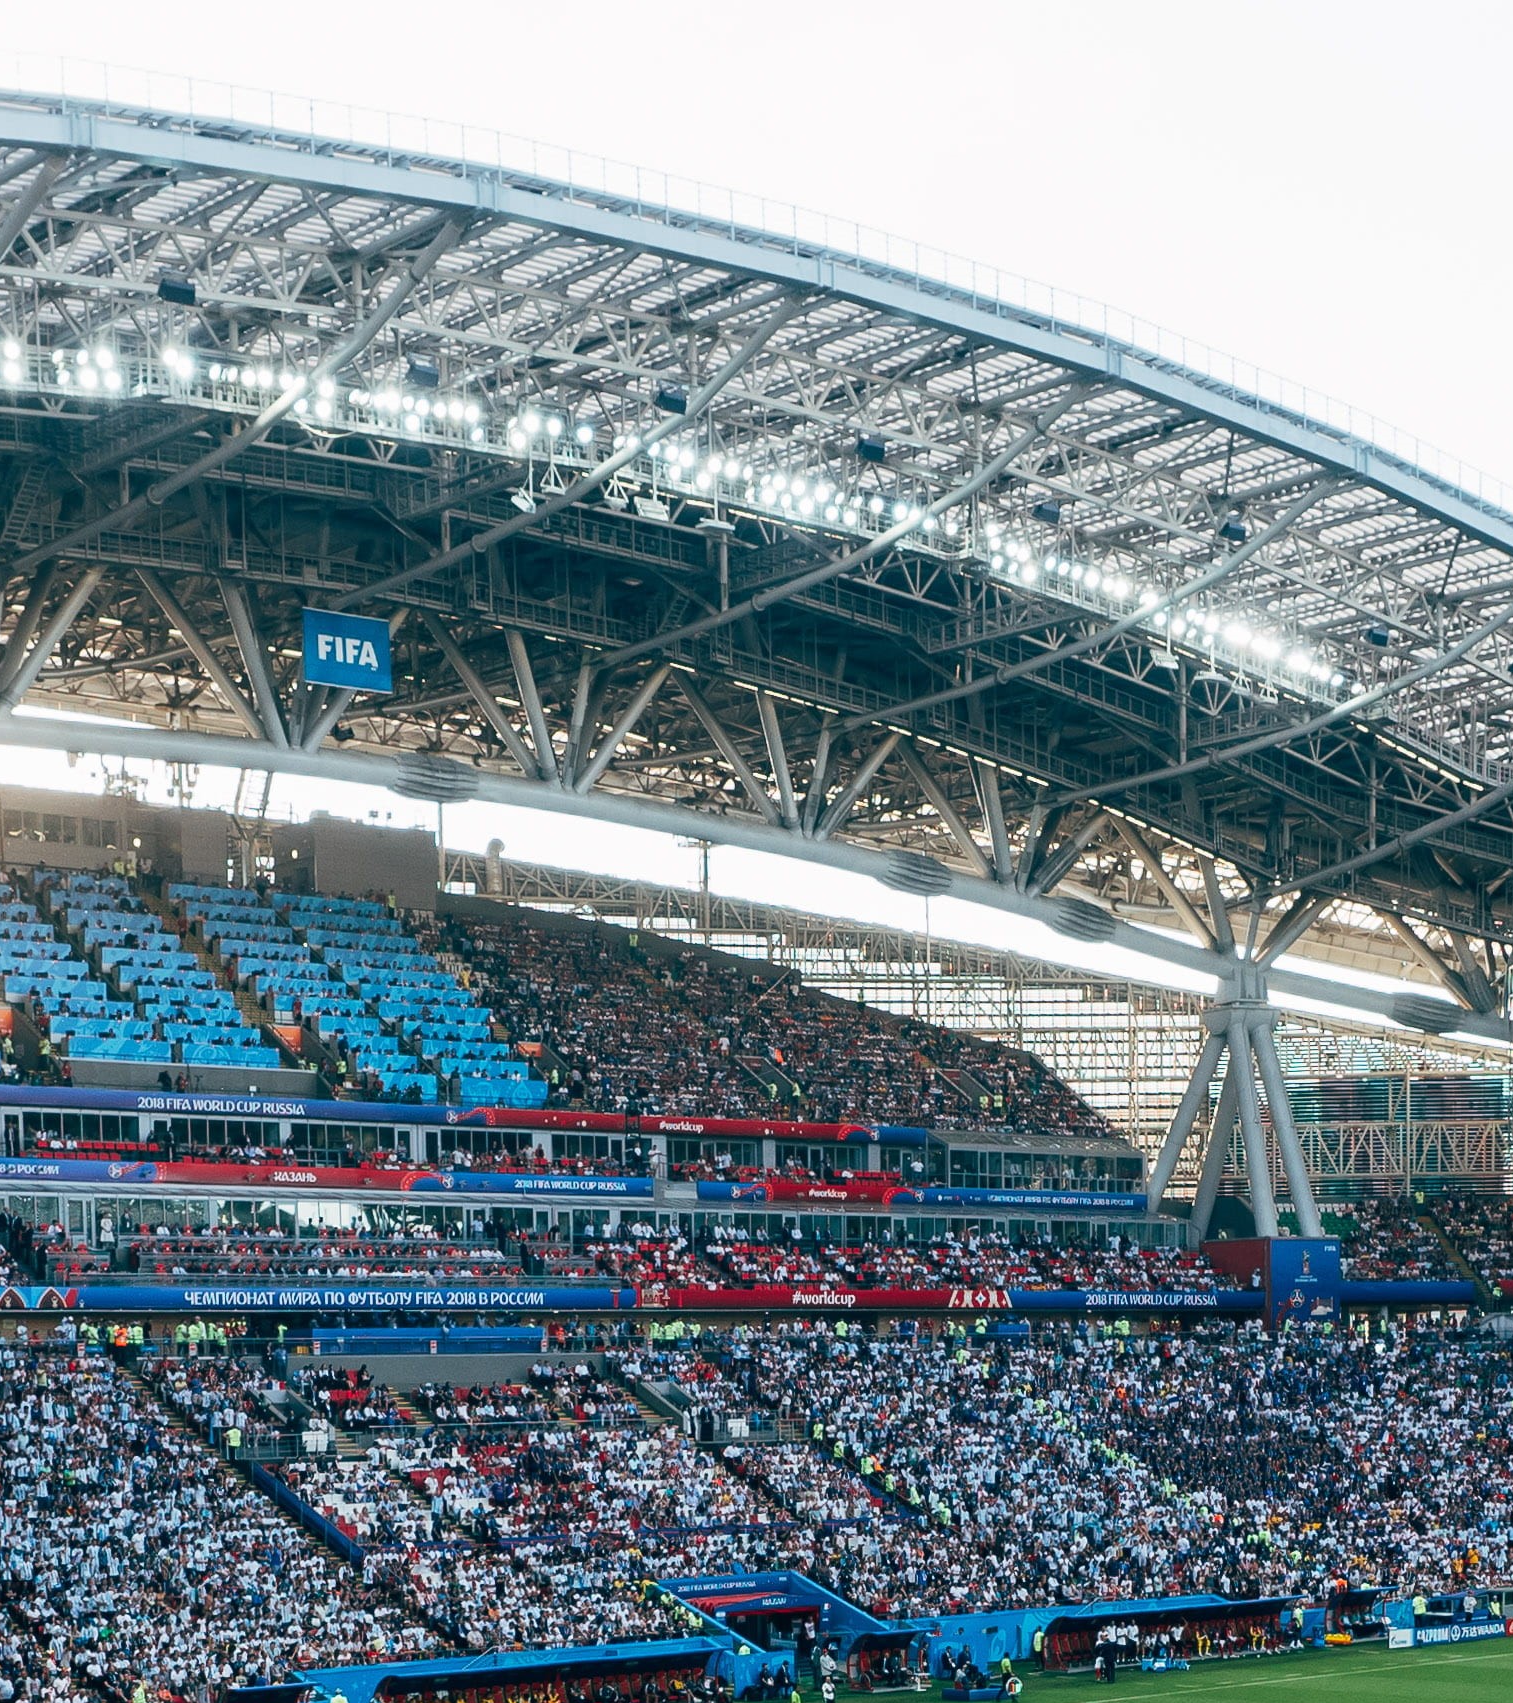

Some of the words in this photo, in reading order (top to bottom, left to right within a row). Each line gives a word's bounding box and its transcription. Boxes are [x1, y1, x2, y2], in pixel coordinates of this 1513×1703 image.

[317, 633, 379, 668] FIFA
[137, 1096, 165, 1110] 2018
[166, 1097, 190, 1110] FIFA
[191, 1098, 234, 1113] WORLD
[236, 1100, 261, 1113] CUP
[262, 1102, 305, 1115] RUSSIA
[659, 1120, 704, 1133] #worldcup
[273, 1171, 317, 1184] КАЗАНЬ
[808, 1188, 848, 1201] #worldcup
[185, 1292, 274, 1306] ЧЕМПИОНАТ
[279, 1292, 322, 1306] МИРА
[324, 1292, 344, 1305] ПО
[347, 1292, 412, 1306] ФУТБОЛУ
[415, 1293, 444, 1305] FIFA
[446, 1293, 477, 1305] 2018
[479, 1293, 488, 1305] В
[490, 1292, 545, 1306] РОССИИ
[791, 1291, 856, 1308] #worldcup
[1086, 1294, 1107, 1306] 2018
[1108, 1294, 1128, 1306] FIFA
[1129, 1294, 1162, 1306] WORLD
[1163, 1294, 1183, 1306] CUP
[1184, 1294, 1217, 1306] RUSSIA
